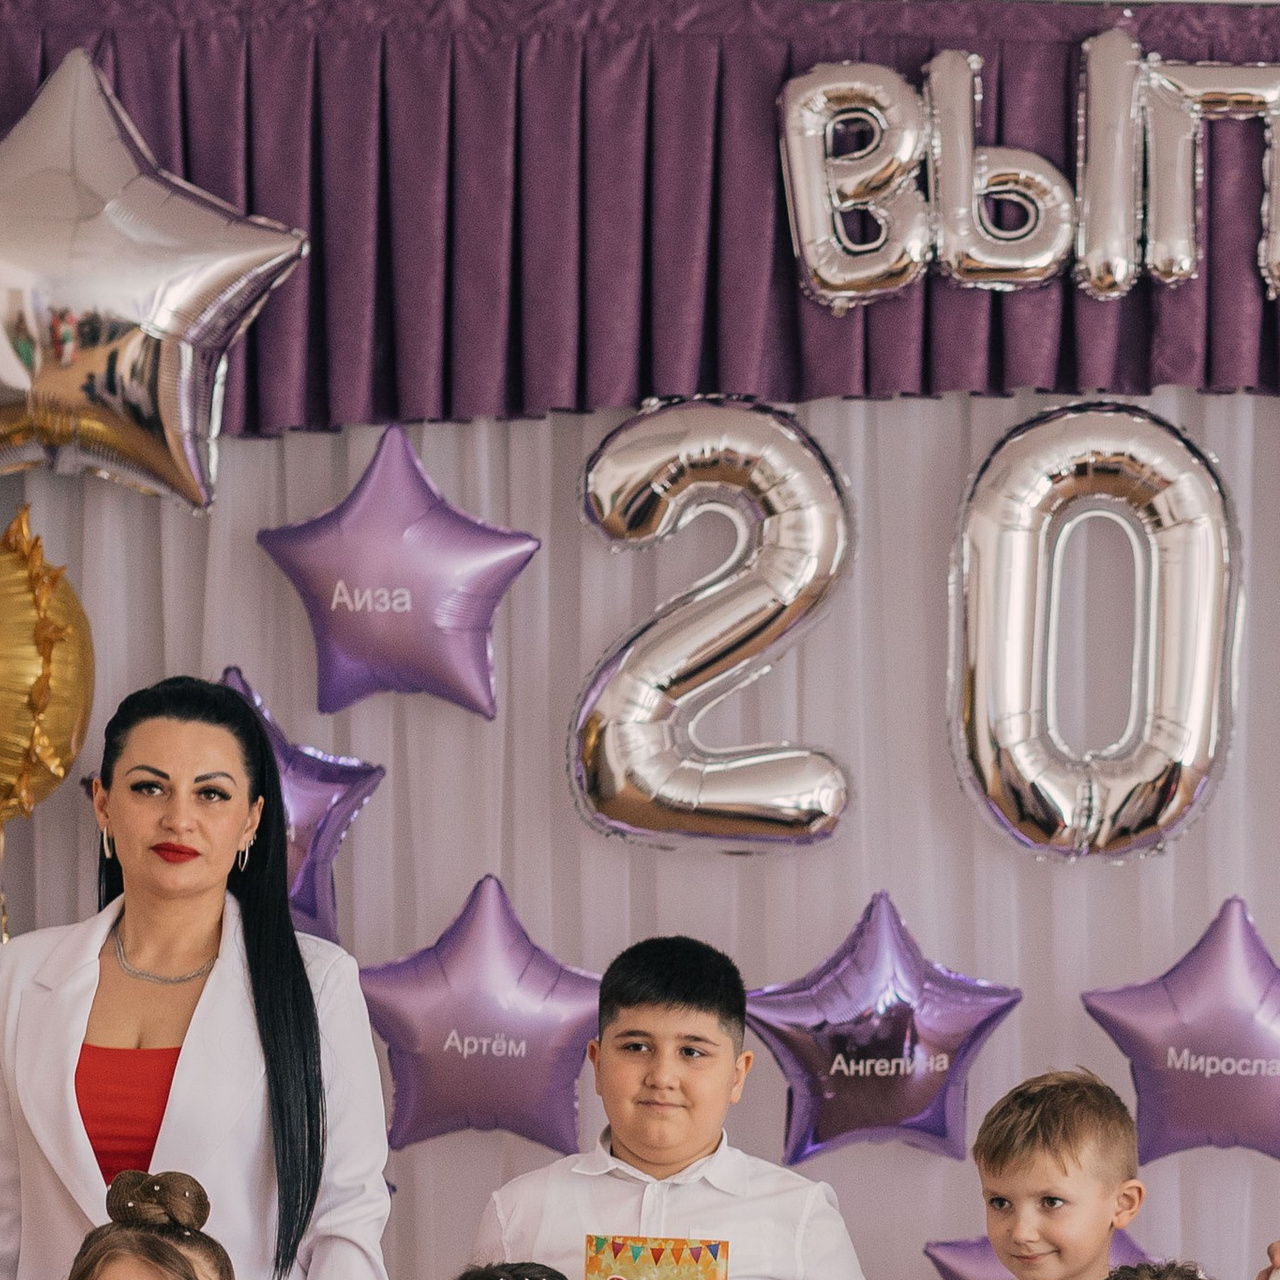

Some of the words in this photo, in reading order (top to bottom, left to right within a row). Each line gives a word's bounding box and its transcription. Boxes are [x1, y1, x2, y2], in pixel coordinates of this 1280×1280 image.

[330, 579, 413, 612] Аиза
[443, 1028, 527, 1058] Артём
[829, 1052, 949, 1078] Ангелина
